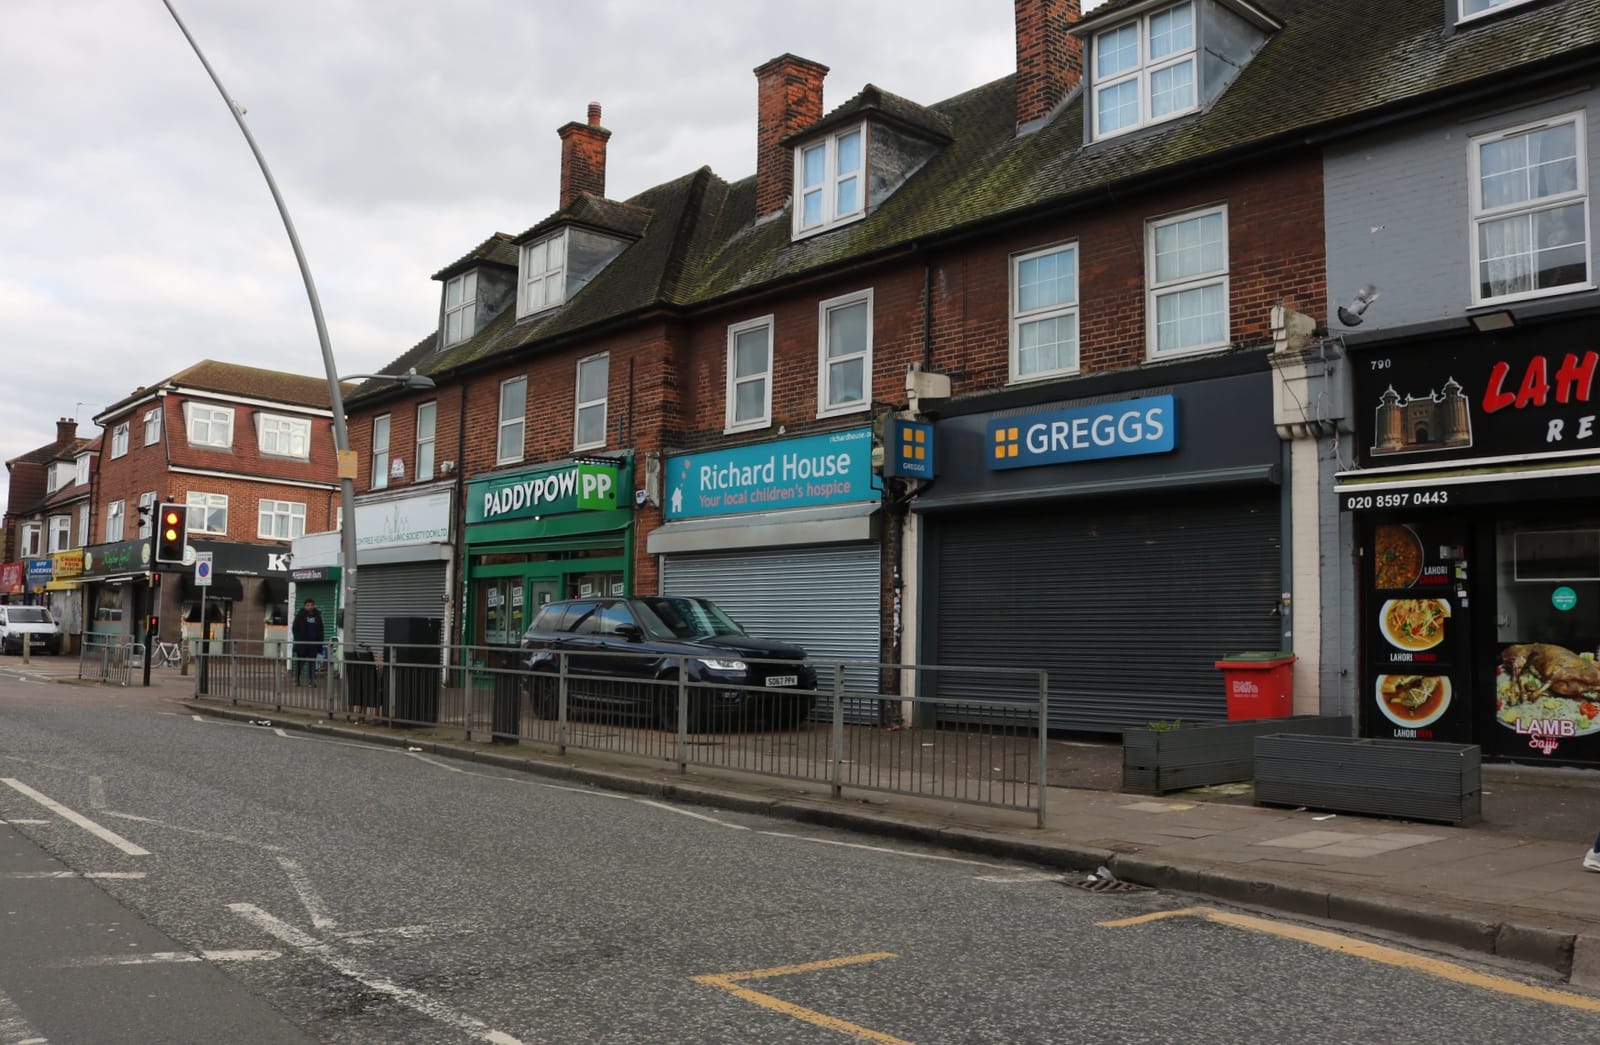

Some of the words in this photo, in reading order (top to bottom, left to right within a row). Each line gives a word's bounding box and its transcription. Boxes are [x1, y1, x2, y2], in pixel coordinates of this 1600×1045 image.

[1370, 358, 1392, 371] 790
[1026, 407, 1164, 454] GREGGS
[699, 455, 775, 491] Richard
[782, 453, 851, 481] House
[902, 462, 925, 472] GREGGS
[699, 494, 721, 508] Your
[724, 489, 748, 505] local
[750, 483, 803, 503] children's
[806, 481, 851, 499] hospice
[1347, 496, 1373, 509] 020
[1376, 493, 1409, 508] 8597
[1413, 491, 1449, 505] 0443
[1424, 566, 1448, 576] LAHORI
[1390, 652, 1413, 662] LAHORI
[1393, 729, 1417, 738] LAHORI
[1515, 717, 1576, 737] LAMB
